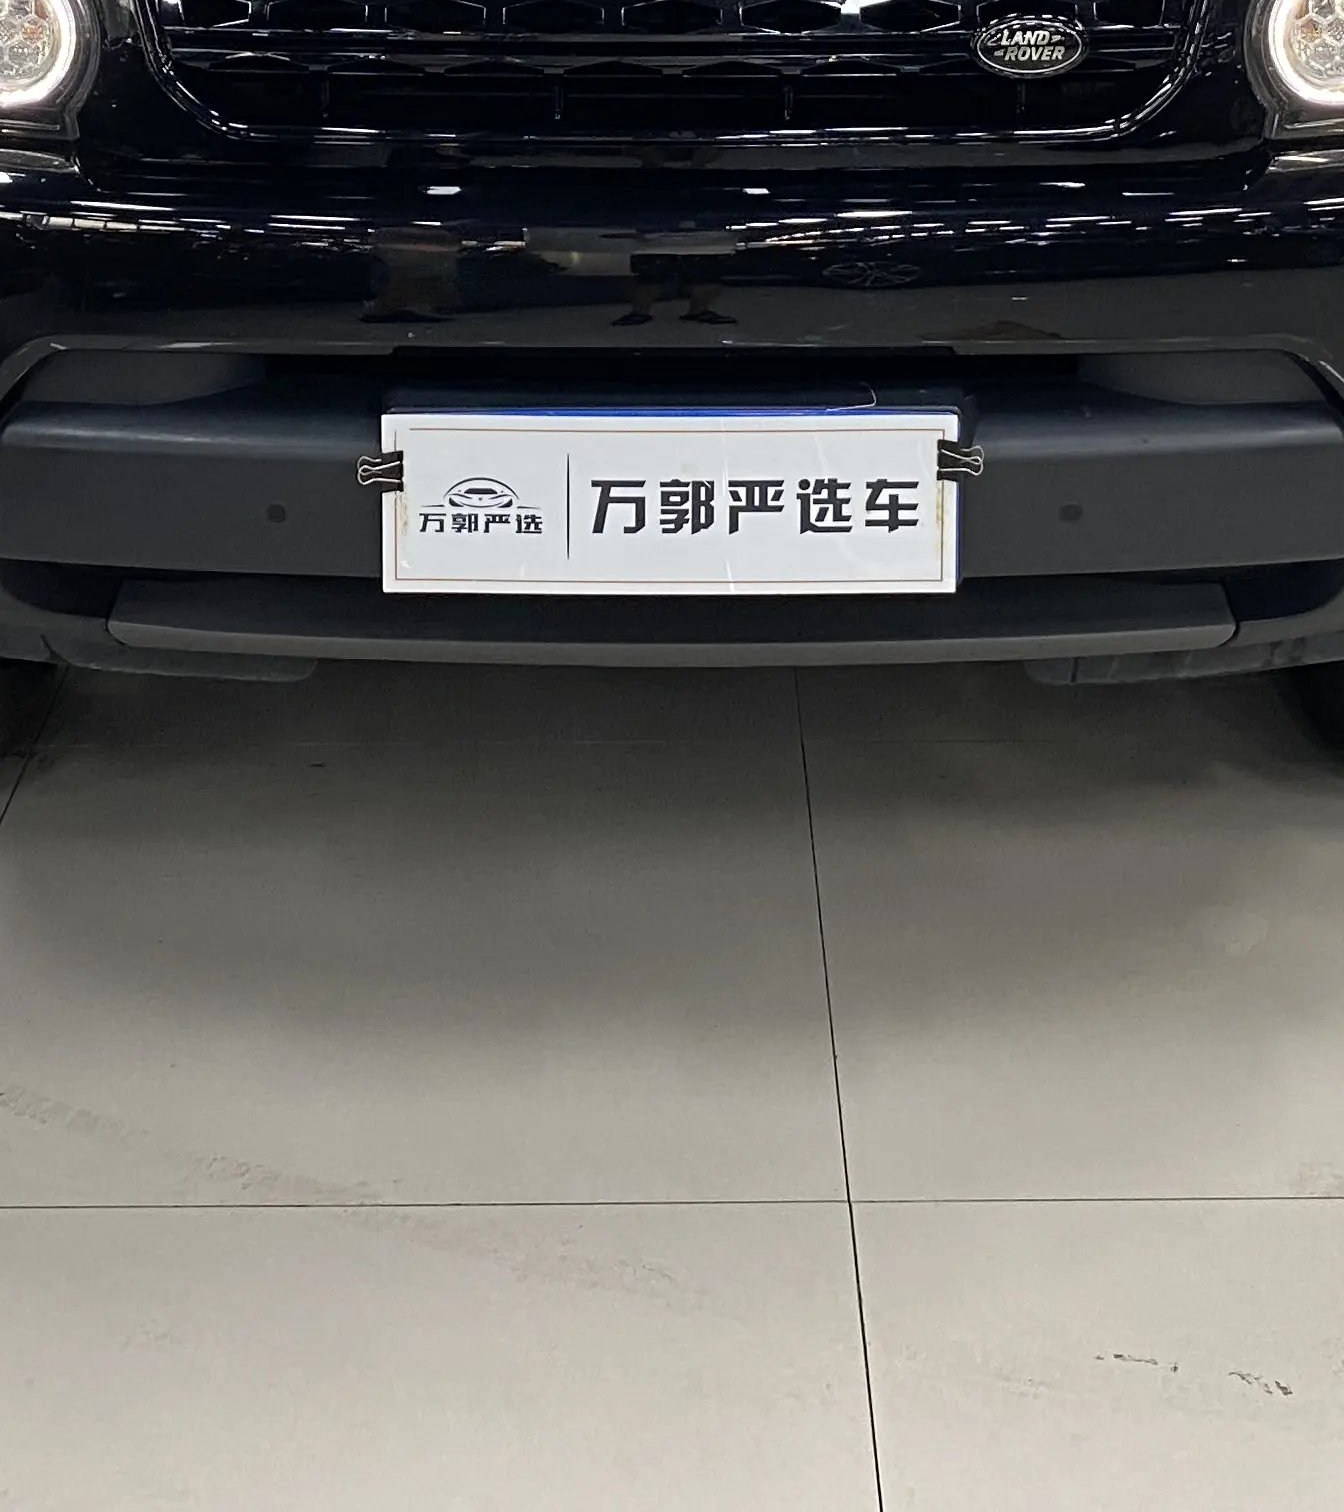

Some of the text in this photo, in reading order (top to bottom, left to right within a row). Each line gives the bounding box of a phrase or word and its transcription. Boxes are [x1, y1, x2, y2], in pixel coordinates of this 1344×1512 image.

[1000, 29, 1050, 46] LAND
[1004, 46, 1065, 61] ROVER
[590, 477, 920, 535] 万郭严选车
[418, 511, 543, 535] 万郭严选
